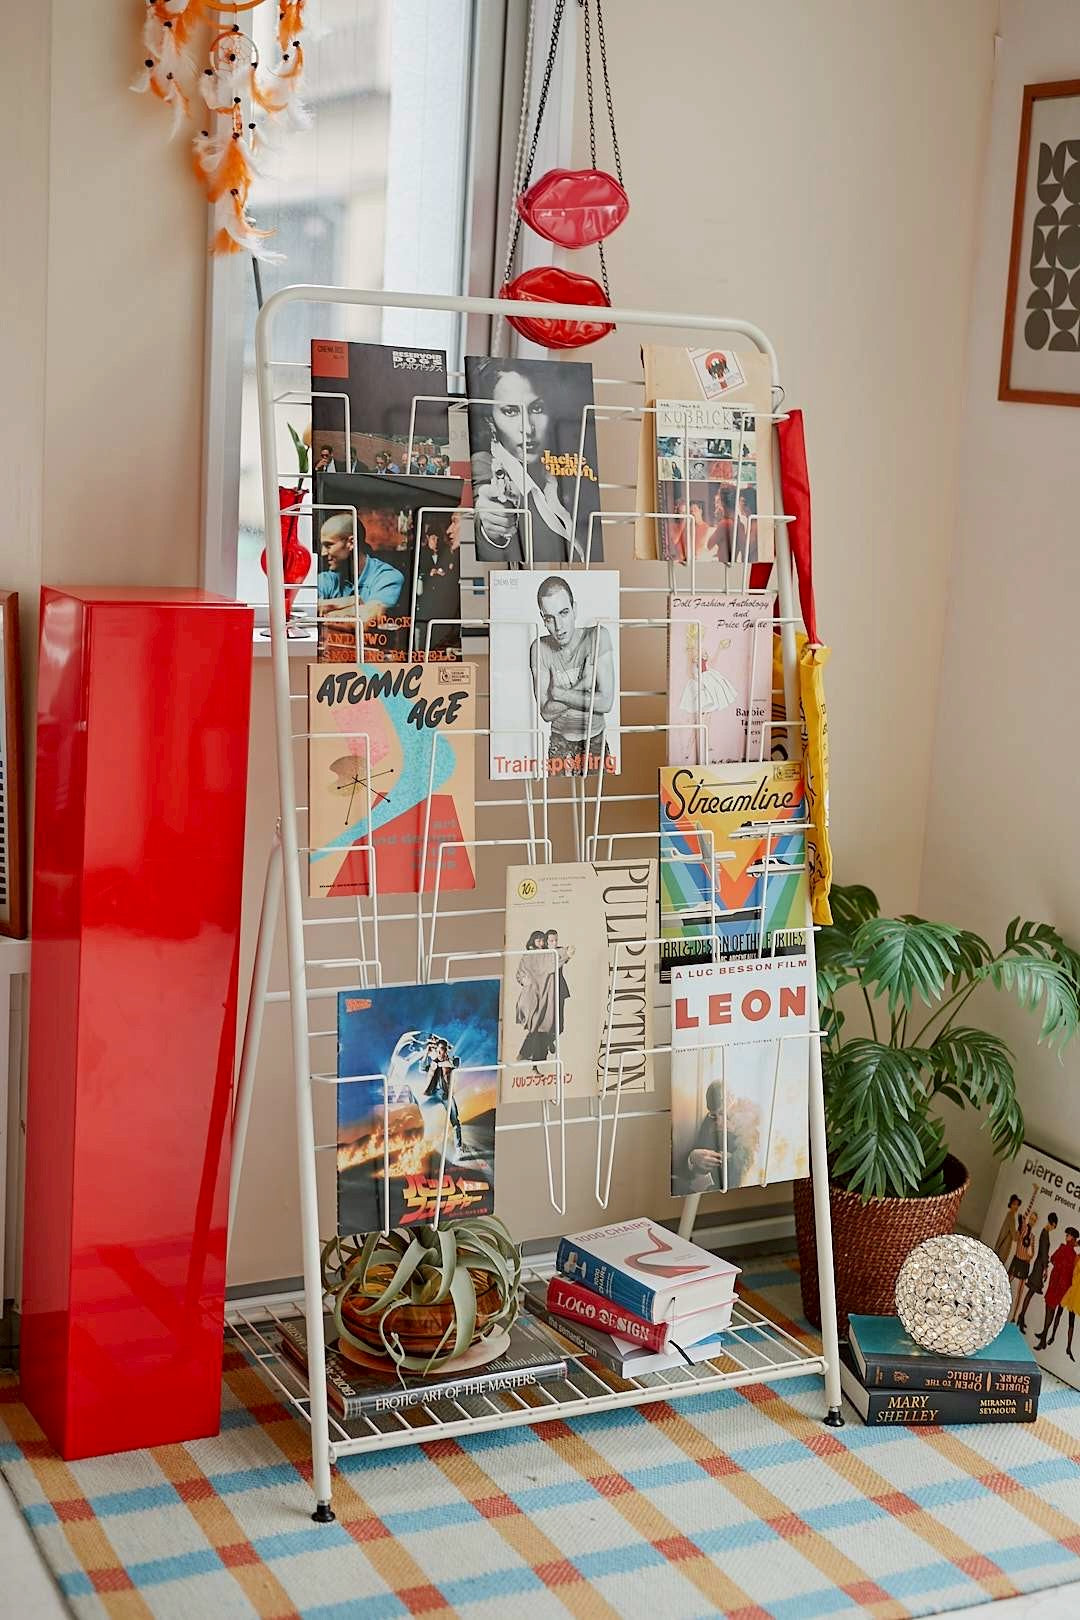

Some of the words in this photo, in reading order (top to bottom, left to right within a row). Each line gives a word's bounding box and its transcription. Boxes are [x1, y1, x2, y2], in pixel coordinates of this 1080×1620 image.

[393, 351, 442, 360] RESERVOIR
[393, 357, 442, 365] DOGS
[673, 599, 692, 608] Doll
[694, 599, 726, 609] Fashion
[727, 598, 770, 610] Anthology
[733, 610, 749, 618] and
[368, 614, 411, 629] STOCK
[717, 619, 740, 629] Price
[742, 619, 768, 631] Gude
[326, 633, 355, 645] AND
[323, 649, 385, 662] SMOKNG
[316, 664, 424, 707] ATOMIC
[406, 691, 469, 731] AGE
[665, 769, 801, 821] Streamline
[591, 859, 651, 956] PULP
[675, 971, 683, 979] A
[688, 968, 714, 978] LUC
[719, 963, 772, 975] BESSON
[777, 959, 808, 969] FILM
[675, 985, 807, 1030] LEON
[596, 959, 647, 1094] FICTION
[1023, 1158, 1064, 1188] pierre
[1040, 1187, 1053, 1198] past
[1054, 1194, 1076, 1211] present
[575, 1230, 606, 1243] 1000
[605, 1221, 651, 1237] CHAIRS
[557, 1291, 597, 1320] LOGO
[598, 1308, 651, 1342] DESIGN
[584, 1340, 599, 1358] turn
[925, 1379, 941, 1387] THE
[947, 1370, 983, 1383] PUBLIC
[999, 1373, 1031, 1385] SPARK
[375, 1393, 419, 1412] EROTIC
[421, 1390, 443, 1403] ART
[445, 1386, 462, 1399] OF
[462, 1382, 487, 1396] THE
[488, 1373, 537, 1392] MASTERS
[954, 1381, 983, 1392] OPEN
[995, 1382, 1030, 1394] MURIEL
[888, 1395, 930, 1409] MARY
[980, 1399, 1017, 1407] MIRANDA
[876, 1409, 939, 1423] SHELLEY
[979, 1407, 1017, 1415] SEYMOUR
